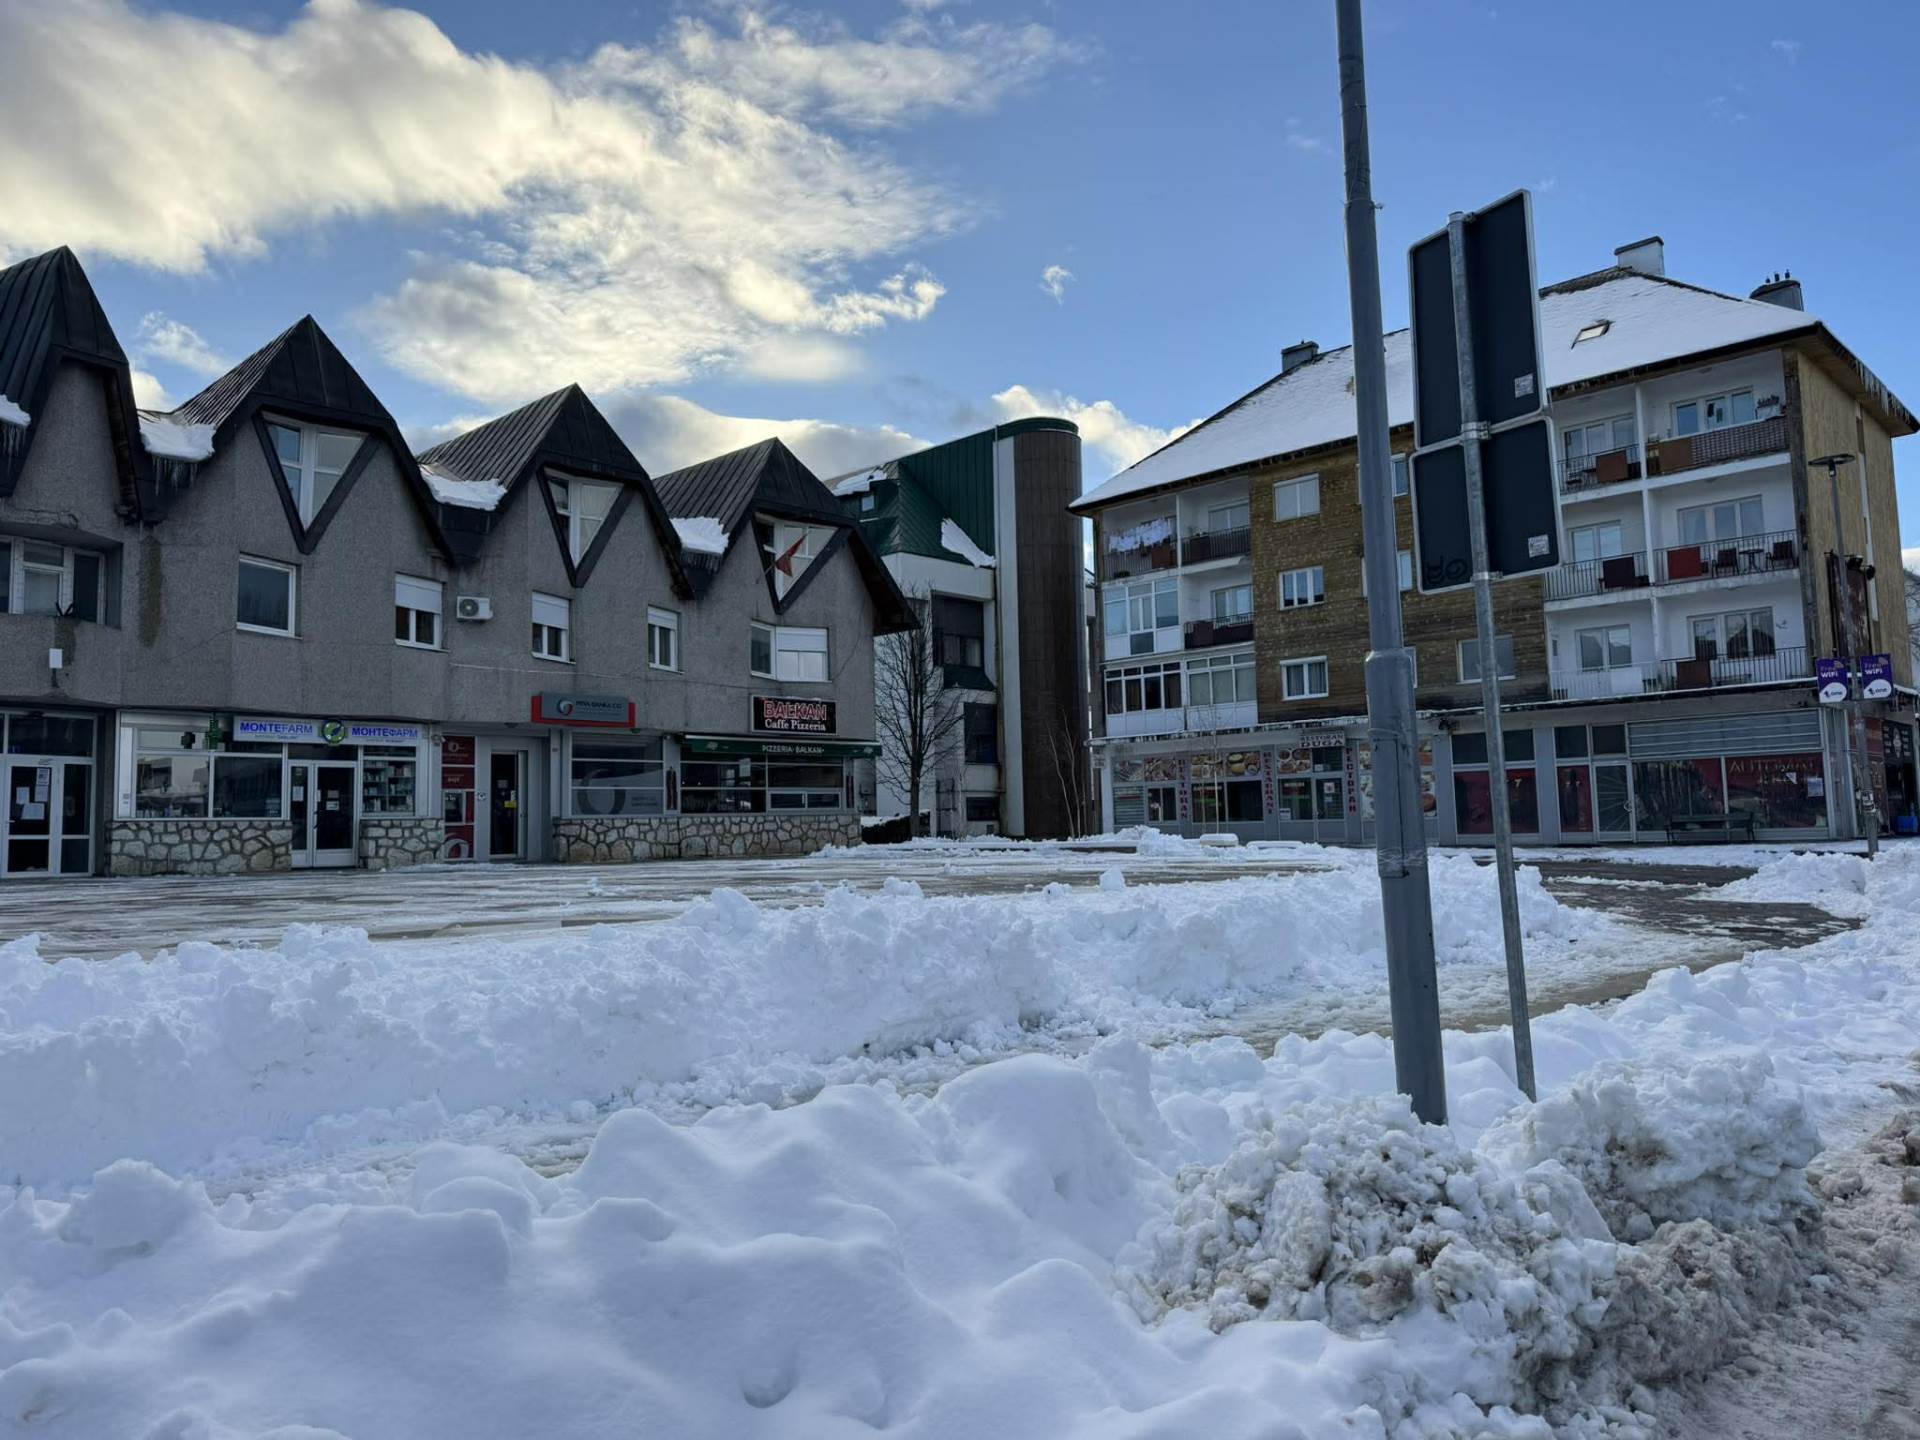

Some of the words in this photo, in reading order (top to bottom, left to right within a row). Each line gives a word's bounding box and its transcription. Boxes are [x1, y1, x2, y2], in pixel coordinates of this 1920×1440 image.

[763, 700, 827, 720] BALKAN
[240, 722, 313, 734] MONTEFARM
[764, 718, 789, 730] Caffe
[791, 720, 827, 731] Pizzeria
[1301, 740, 1343, 748] DUGA
